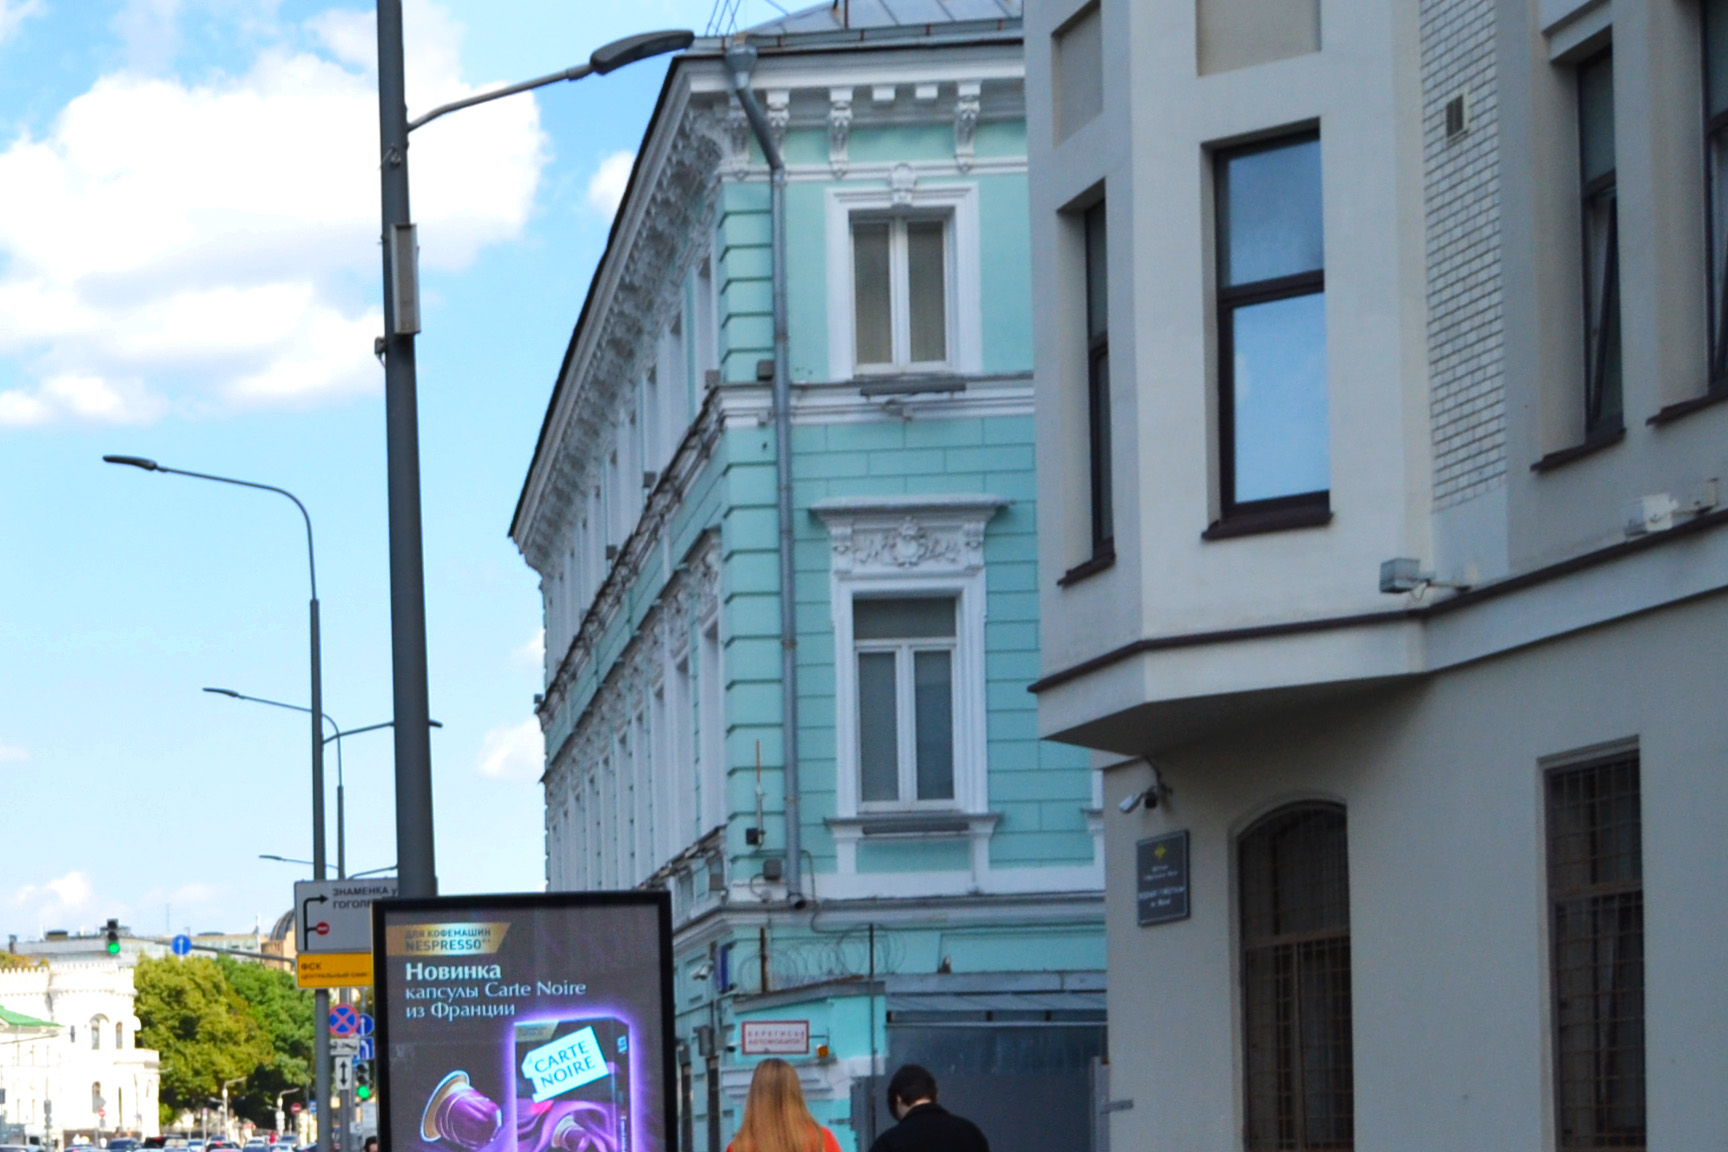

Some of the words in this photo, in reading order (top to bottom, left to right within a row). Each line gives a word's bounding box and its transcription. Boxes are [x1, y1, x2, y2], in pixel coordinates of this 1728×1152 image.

[333, 886, 389, 897] ЗНАМЕНКА
[405, 930, 426, 940] ДЛЯ
[427, 927, 491, 938] КОФЕМАШИН
[301, 962, 321, 971] ФСК
[405, 962, 502, 982] Новинка
[405, 986, 479, 1003] капсулы
[484, 981, 532, 998] Carte
[536, 979, 587, 997] Noire
[406, 1006, 425, 1018] из
[430, 1001, 516, 1022] Франции
[534, 1040, 590, 1074] CARTE
[541, 1055, 596, 1088] NOIRE
